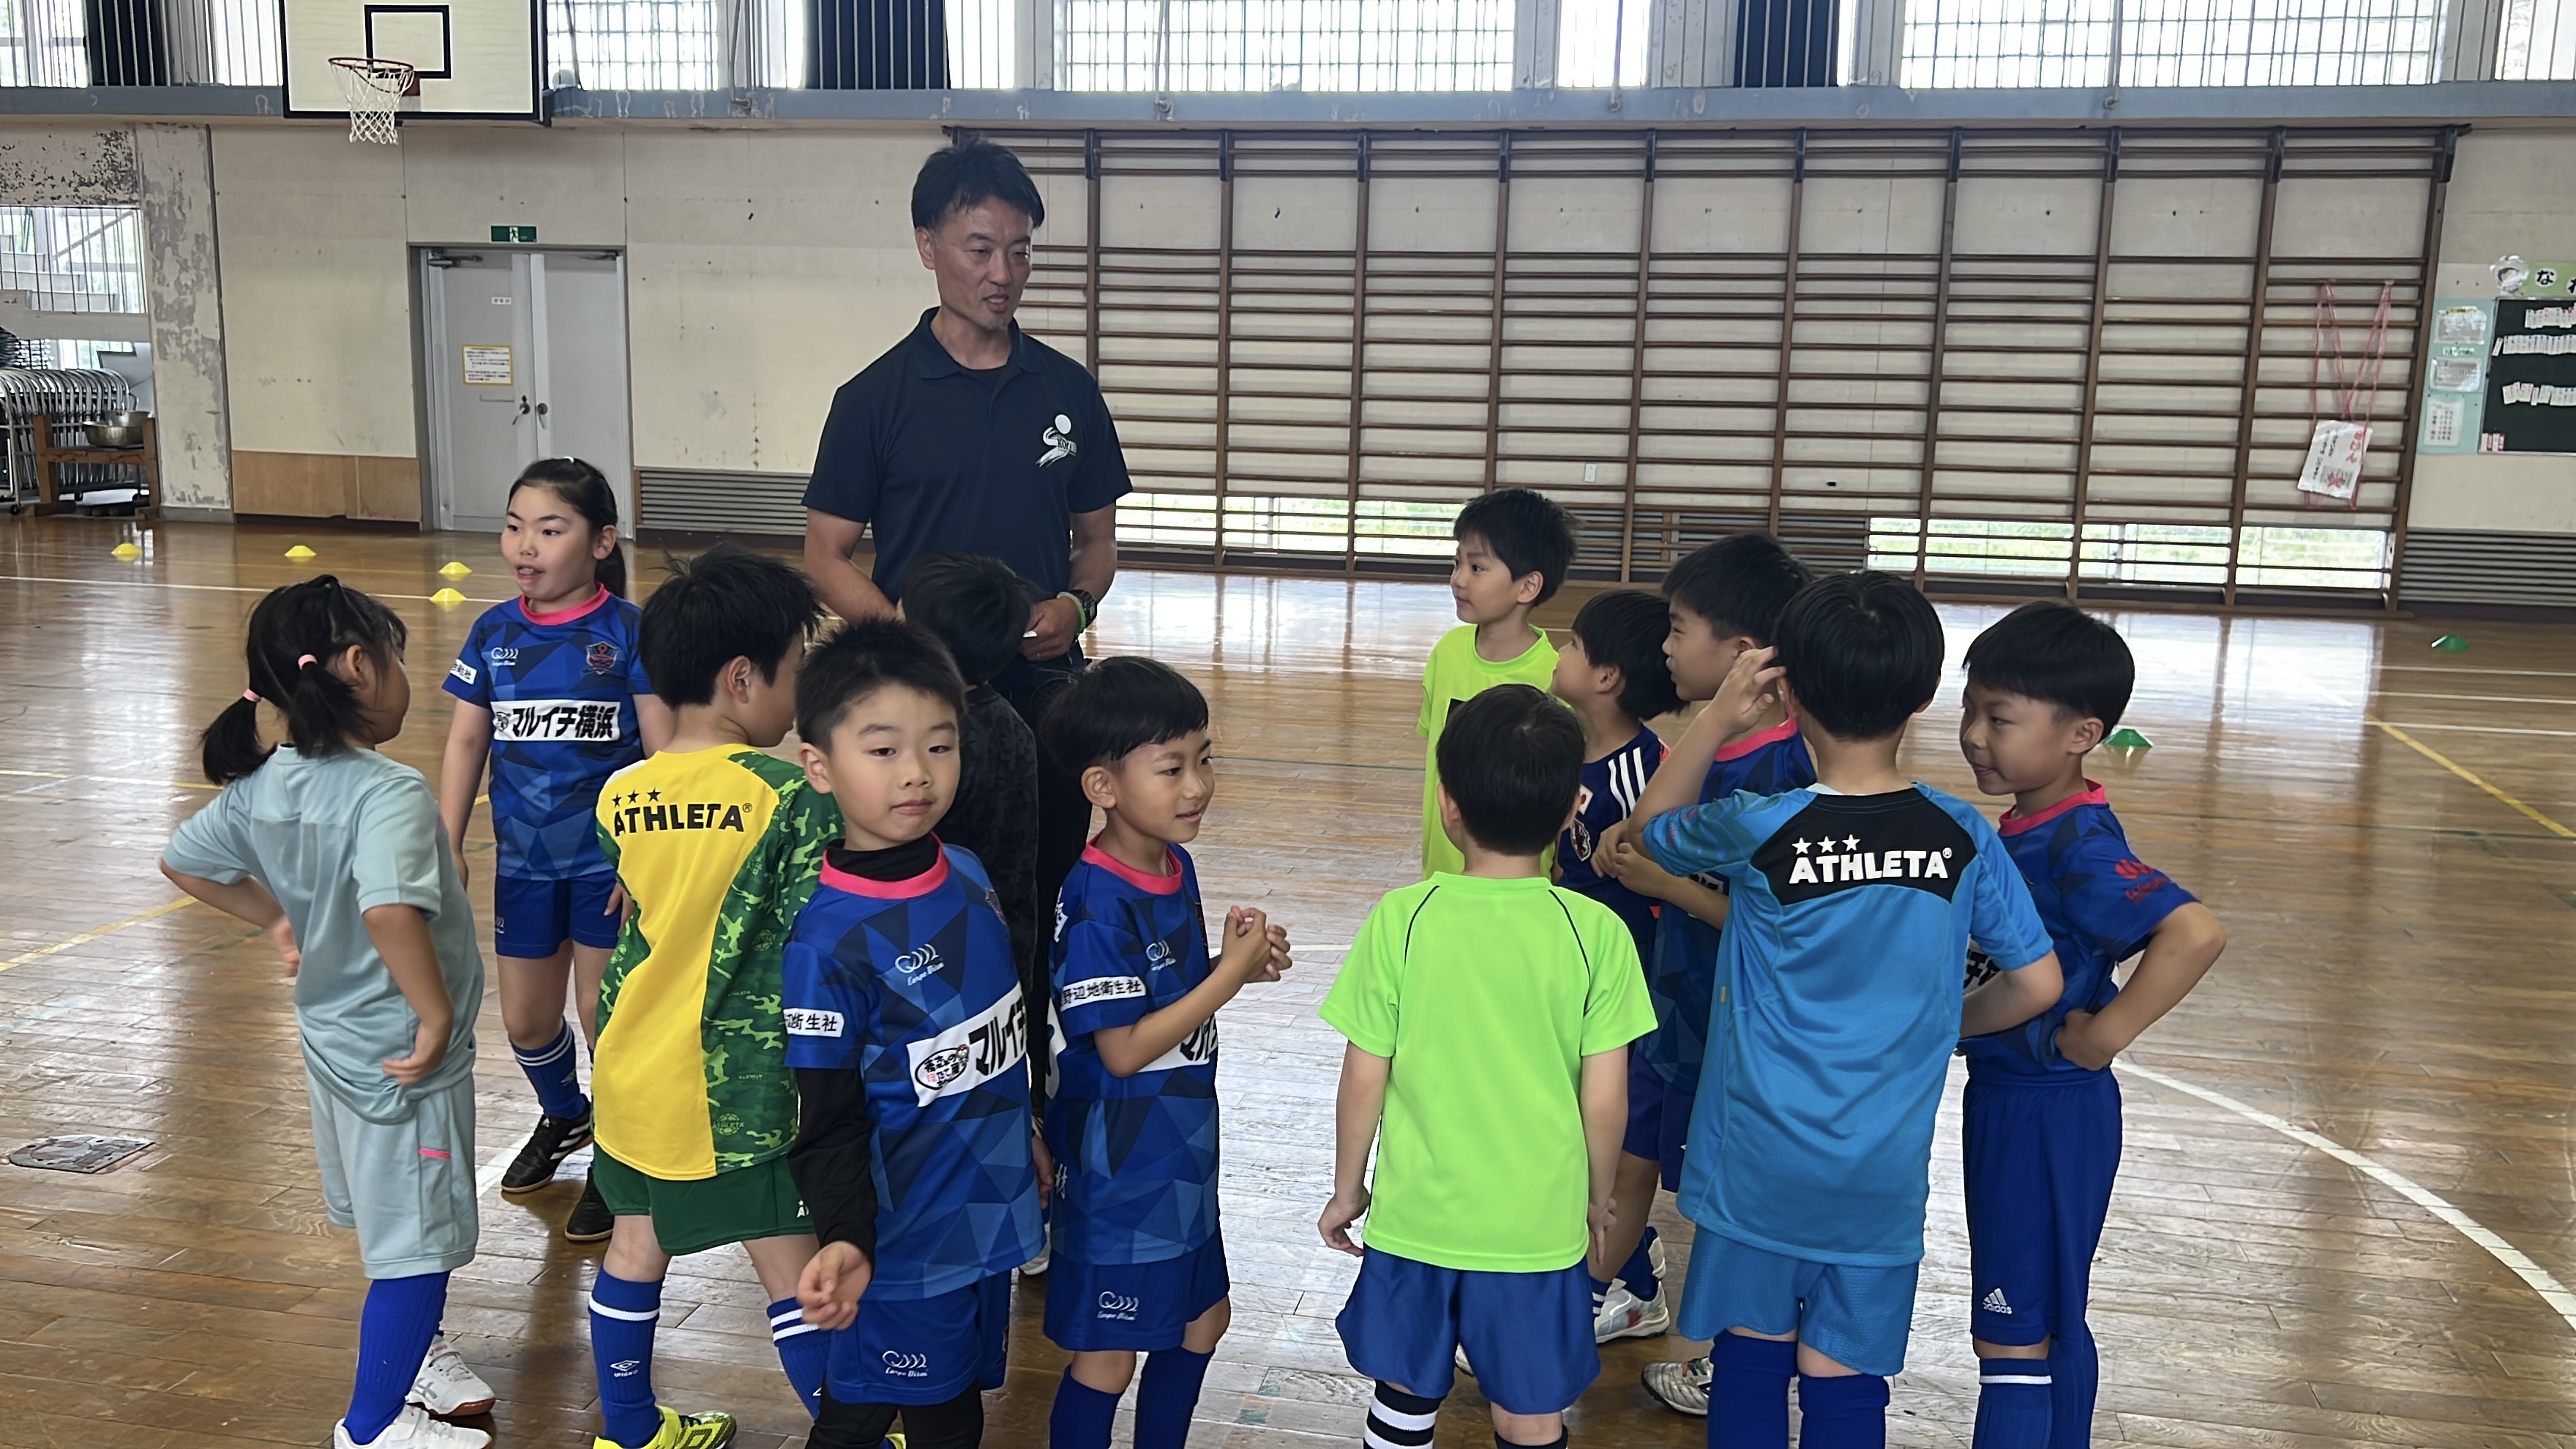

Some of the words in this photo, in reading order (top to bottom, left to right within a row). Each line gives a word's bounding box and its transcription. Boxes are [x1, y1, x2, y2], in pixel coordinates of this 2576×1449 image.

[512, 705, 617, 738] マルイチ横浜
[613, 803, 744, 837] ATHLETA
[1789, 850, 1948, 884] ATHLETA
[1982, 1302, 2012, 1314] adidas
